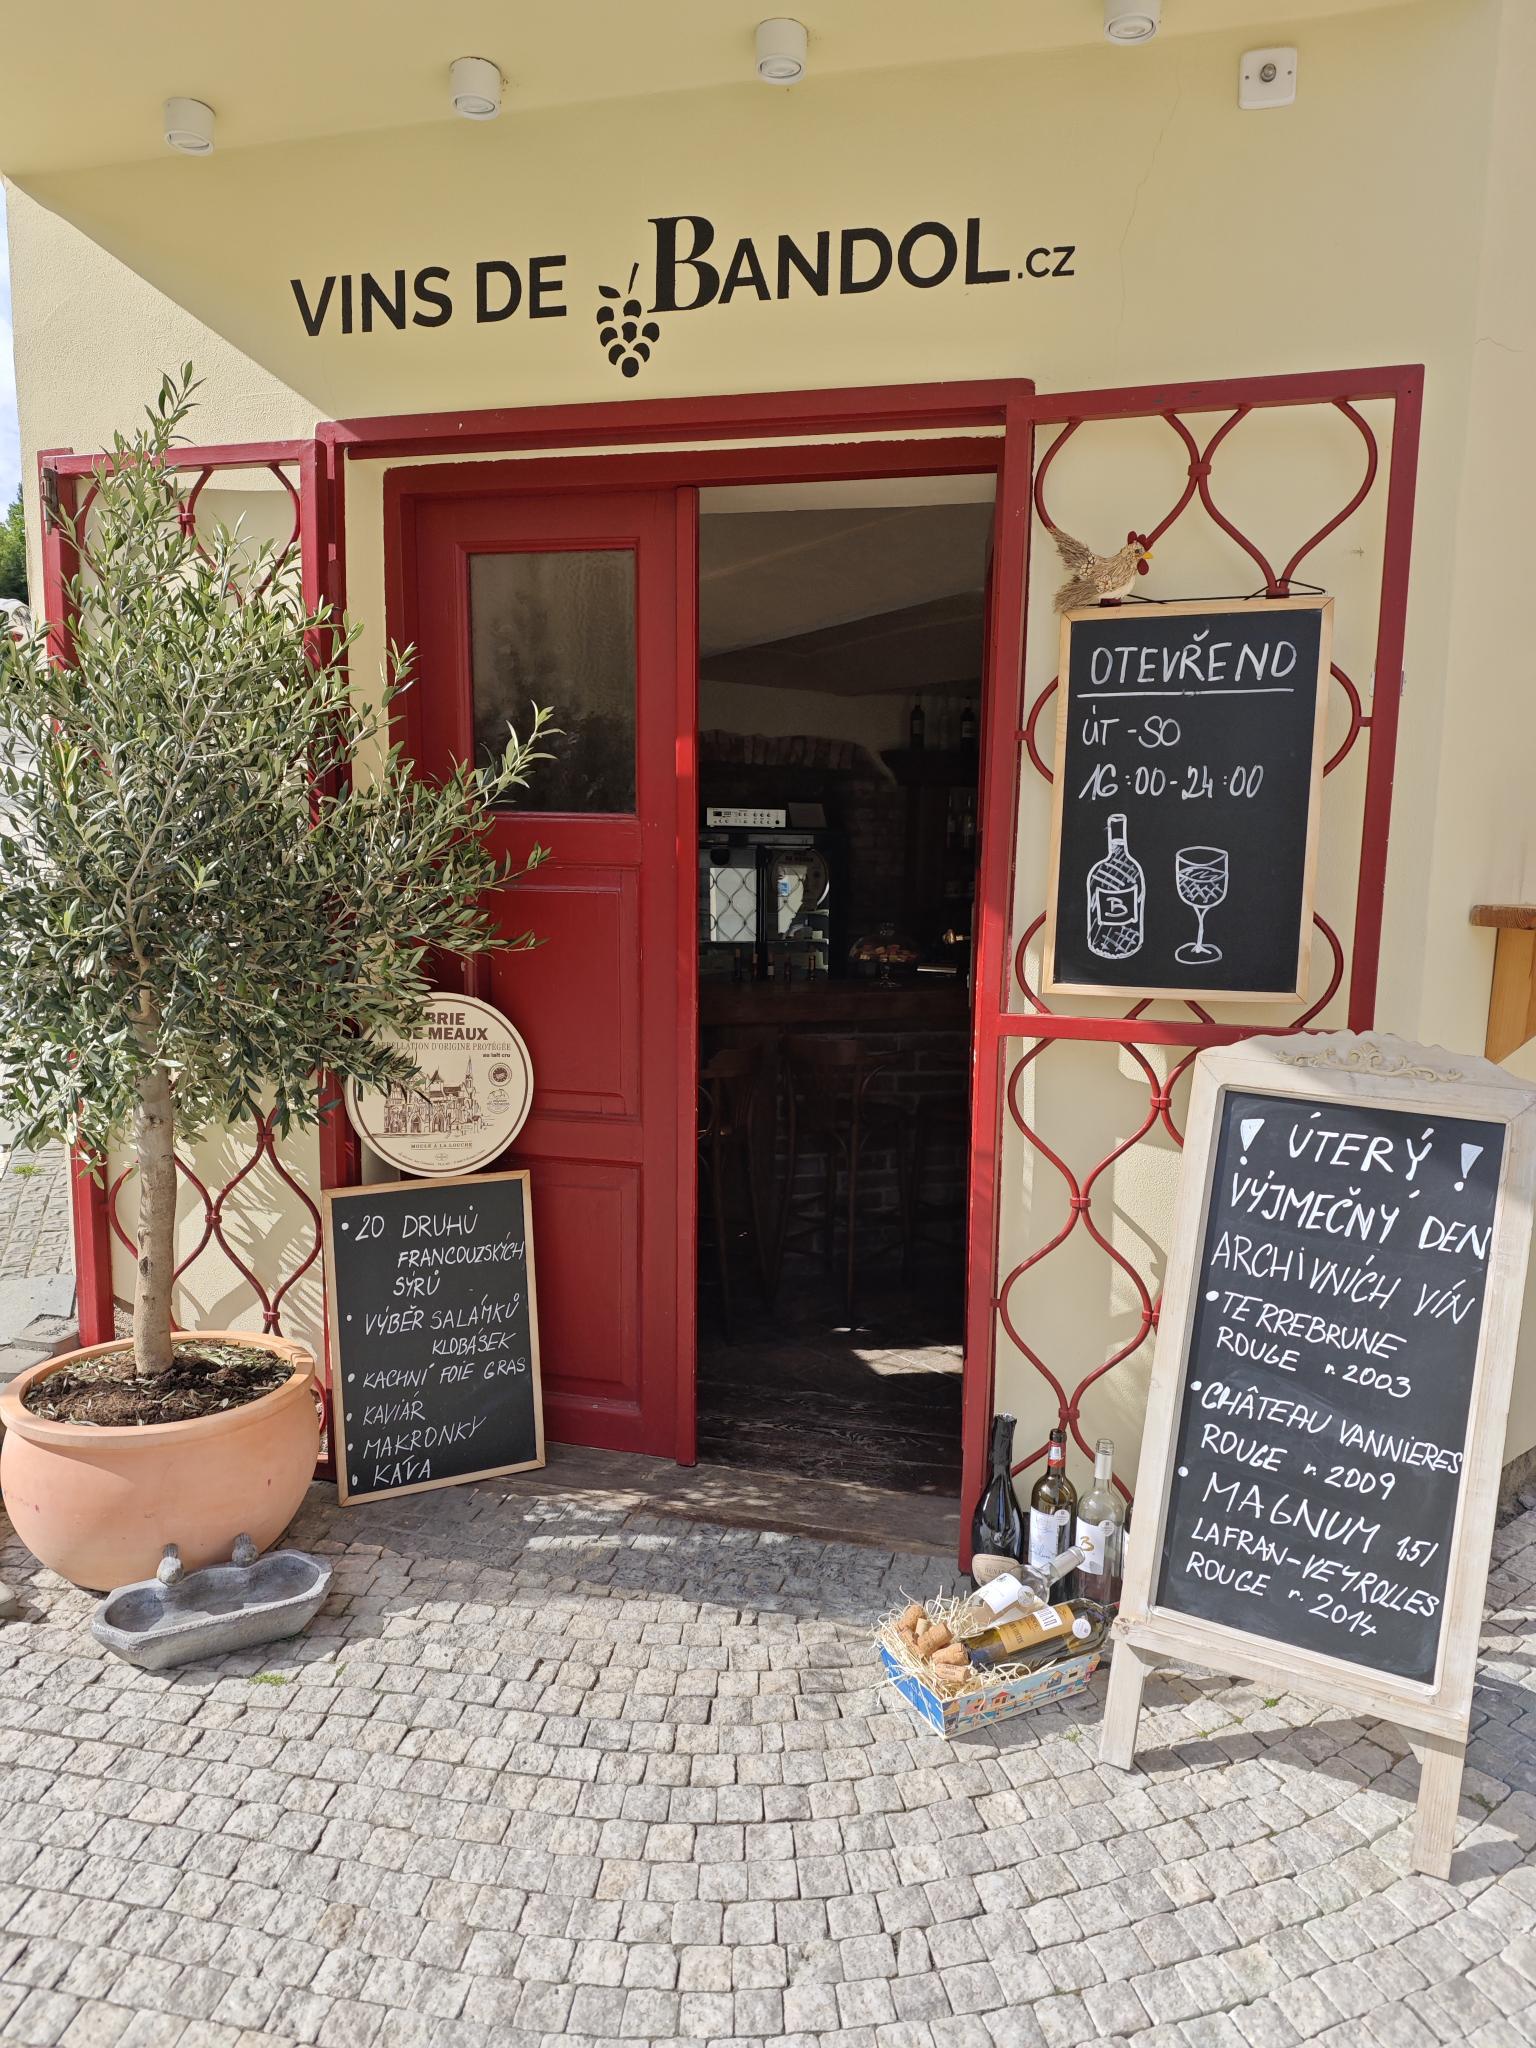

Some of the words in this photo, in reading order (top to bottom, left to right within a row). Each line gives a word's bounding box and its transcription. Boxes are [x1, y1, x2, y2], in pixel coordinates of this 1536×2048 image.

[291, 266, 453, 336] VINS
[475, 255, 567, 323] DE
[1090, 629, 1297, 685] OTEVŘENO
[1082, 704, 1120, 746] ÚT
[1105, 897, 1128, 917] B
[428, 1027, 489, 1041] MEAUX
[1289, 1111, 1435, 1181] ÚTERÝ
[355, 1215, 385, 1241] 20
[402, 1204, 479, 1238] DRUHŮ
[1231, 1170, 1421, 1244] VÝJMEČNÝ
[1418, 1215, 1492, 1260] DEN
[397, 1231, 526, 1268] FRANCOUZSKÝCH
[393, 1269, 441, 1298] SÝRŮ
[1413, 1279, 1475, 1325] VÍN
[365, 1305, 424, 1336] VÝBĚR
[430, 1293, 520, 1330] SALÁMKŮ
[1223, 1290, 1407, 1359] TERREBRUNE
[432, 1328, 517, 1356] KLOBÁSEK
[1216, 1326, 1300, 1372] ROUGE
[1342, 1364, 1412, 1398] 2003
[363, 1363, 435, 1389] KACHNÍ
[439, 1361, 475, 1384] FOIE
[484, 1357, 526, 1380] GRAS
[363, 1391, 426, 1426] KAVIÁR
[1201, 1385, 1334, 1434] CHÂTEAU
[363, 1415, 487, 1459] MAKRONKY
[373, 1456, 431, 1487] KÁVA
[1200, 1423, 1288, 1472] ROUGE
[1324, 1465, 1396, 1500] 2009
[1202, 1472, 1381, 1554] MAGNUM
[1191, 1517, 1440, 1618] LAFRAN-VEYROLLES
[1186, 1551, 1271, 1597] ROUGE
[1309, 1593, 1377, 1637] 2014
